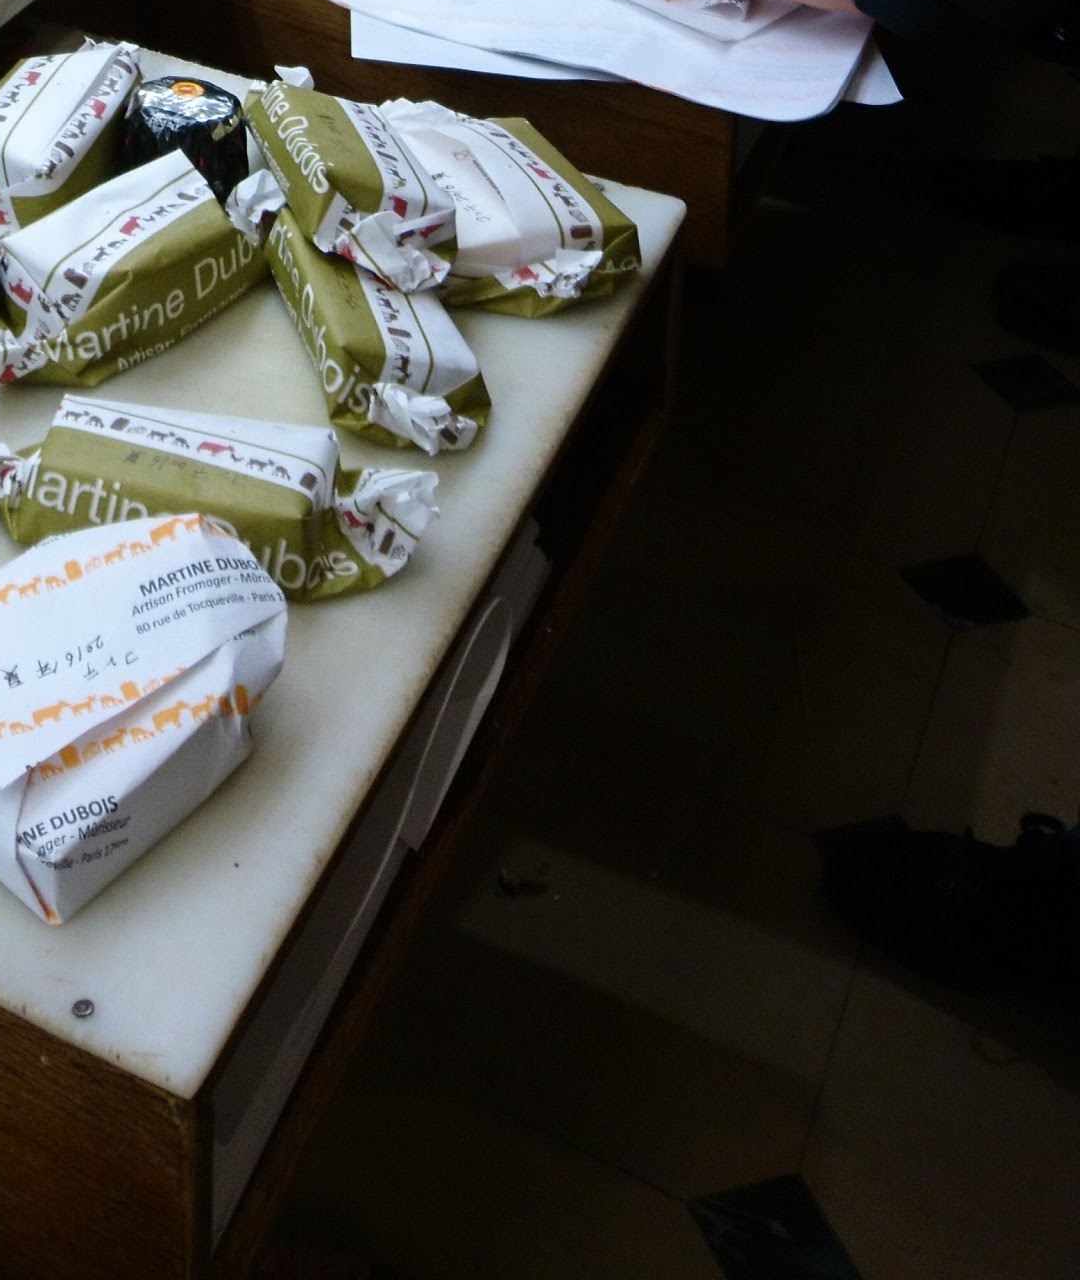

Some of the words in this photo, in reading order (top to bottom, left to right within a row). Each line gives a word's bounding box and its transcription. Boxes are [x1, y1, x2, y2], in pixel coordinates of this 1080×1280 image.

[192, 232, 260, 300] Dub
[12, 462, 148, 528] Martin
[131, 591, 175, 617] Artisan
[175, 576, 231, 605] Fromager
[138, 558, 214, 598] MARTINE
[136, 622, 151, 635] 80
[152, 616, 171, 629] rue
[172, 609, 186, 622] de
[188, 592, 246, 617] Tocqueville
[251, 590, 277, 604] Paris
[50, 795, 119, 832] DUBOIS
